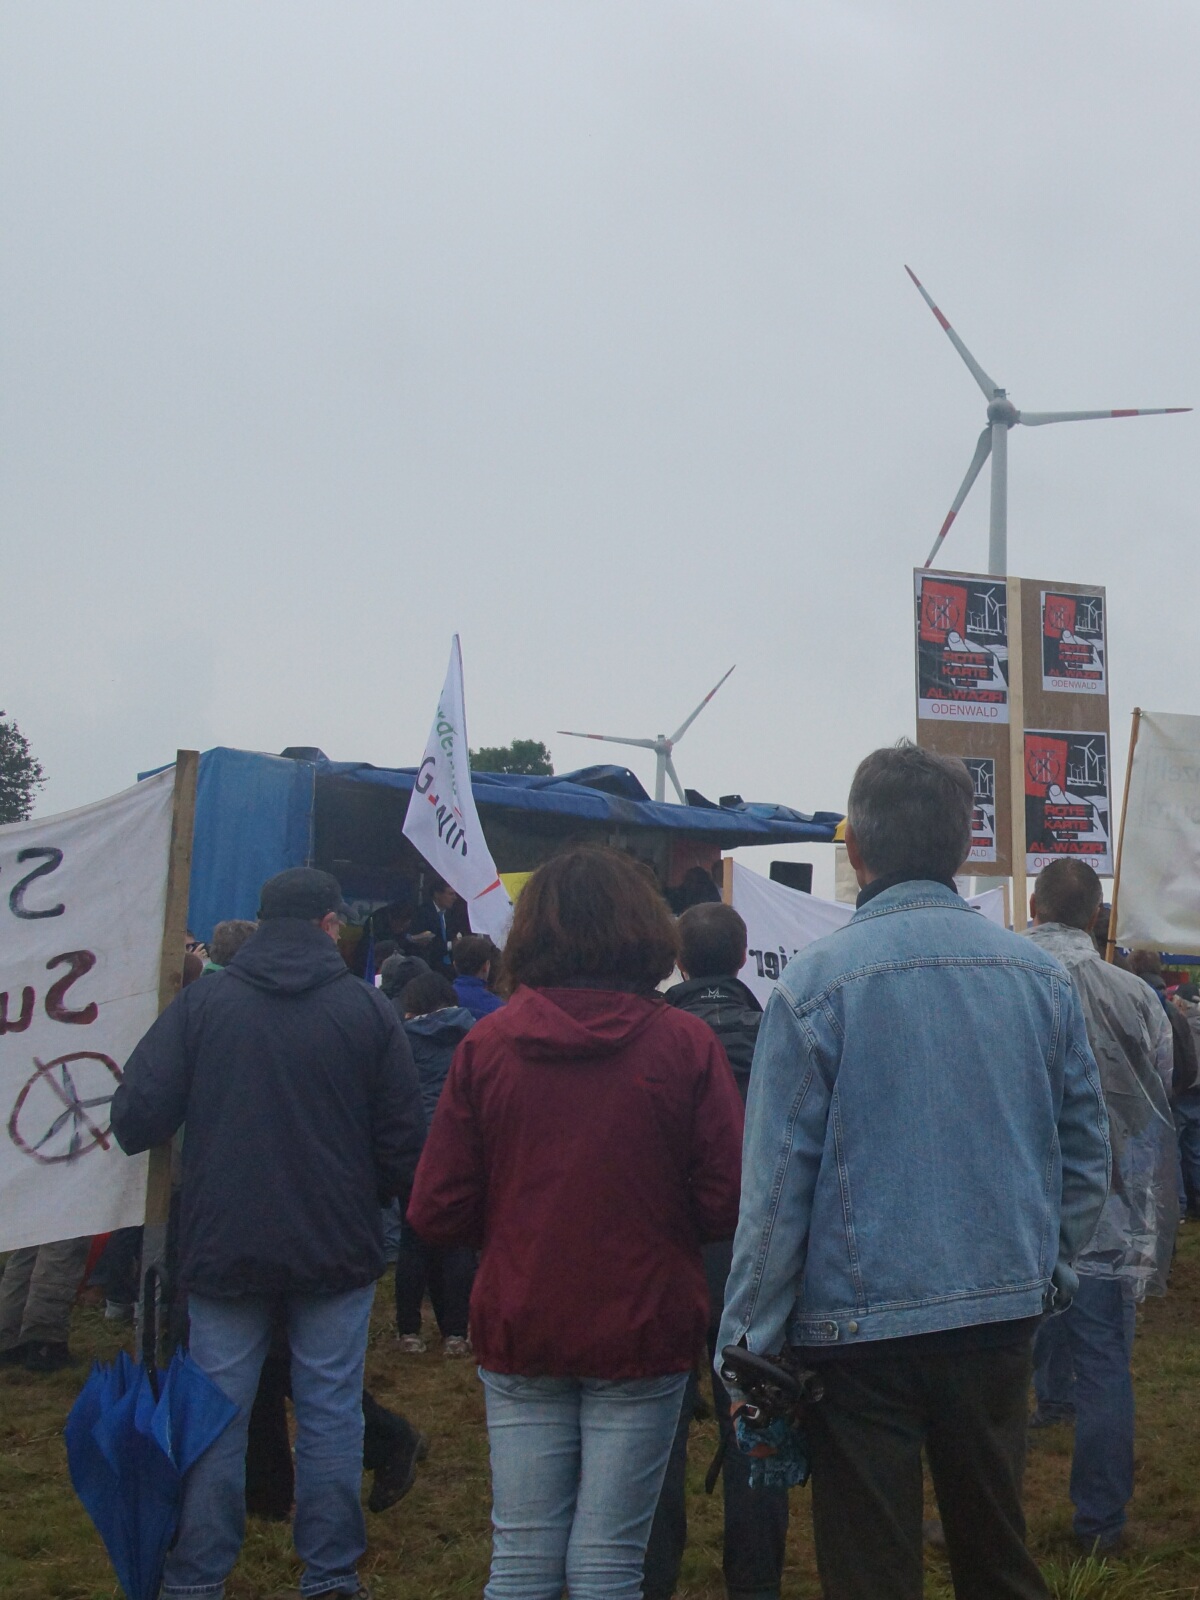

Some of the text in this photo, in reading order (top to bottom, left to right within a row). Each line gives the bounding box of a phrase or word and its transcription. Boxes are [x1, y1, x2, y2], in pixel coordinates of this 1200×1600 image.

[943, 652, 987, 664] ROTE
[942, 666, 989, 679] KARTE
[1051, 679, 1097, 690] ODENWALD
[931, 703, 998, 718] ODENWALD
[1044, 804, 1086, 817] ROTE
[1044, 820, 1089, 831] KARTE
